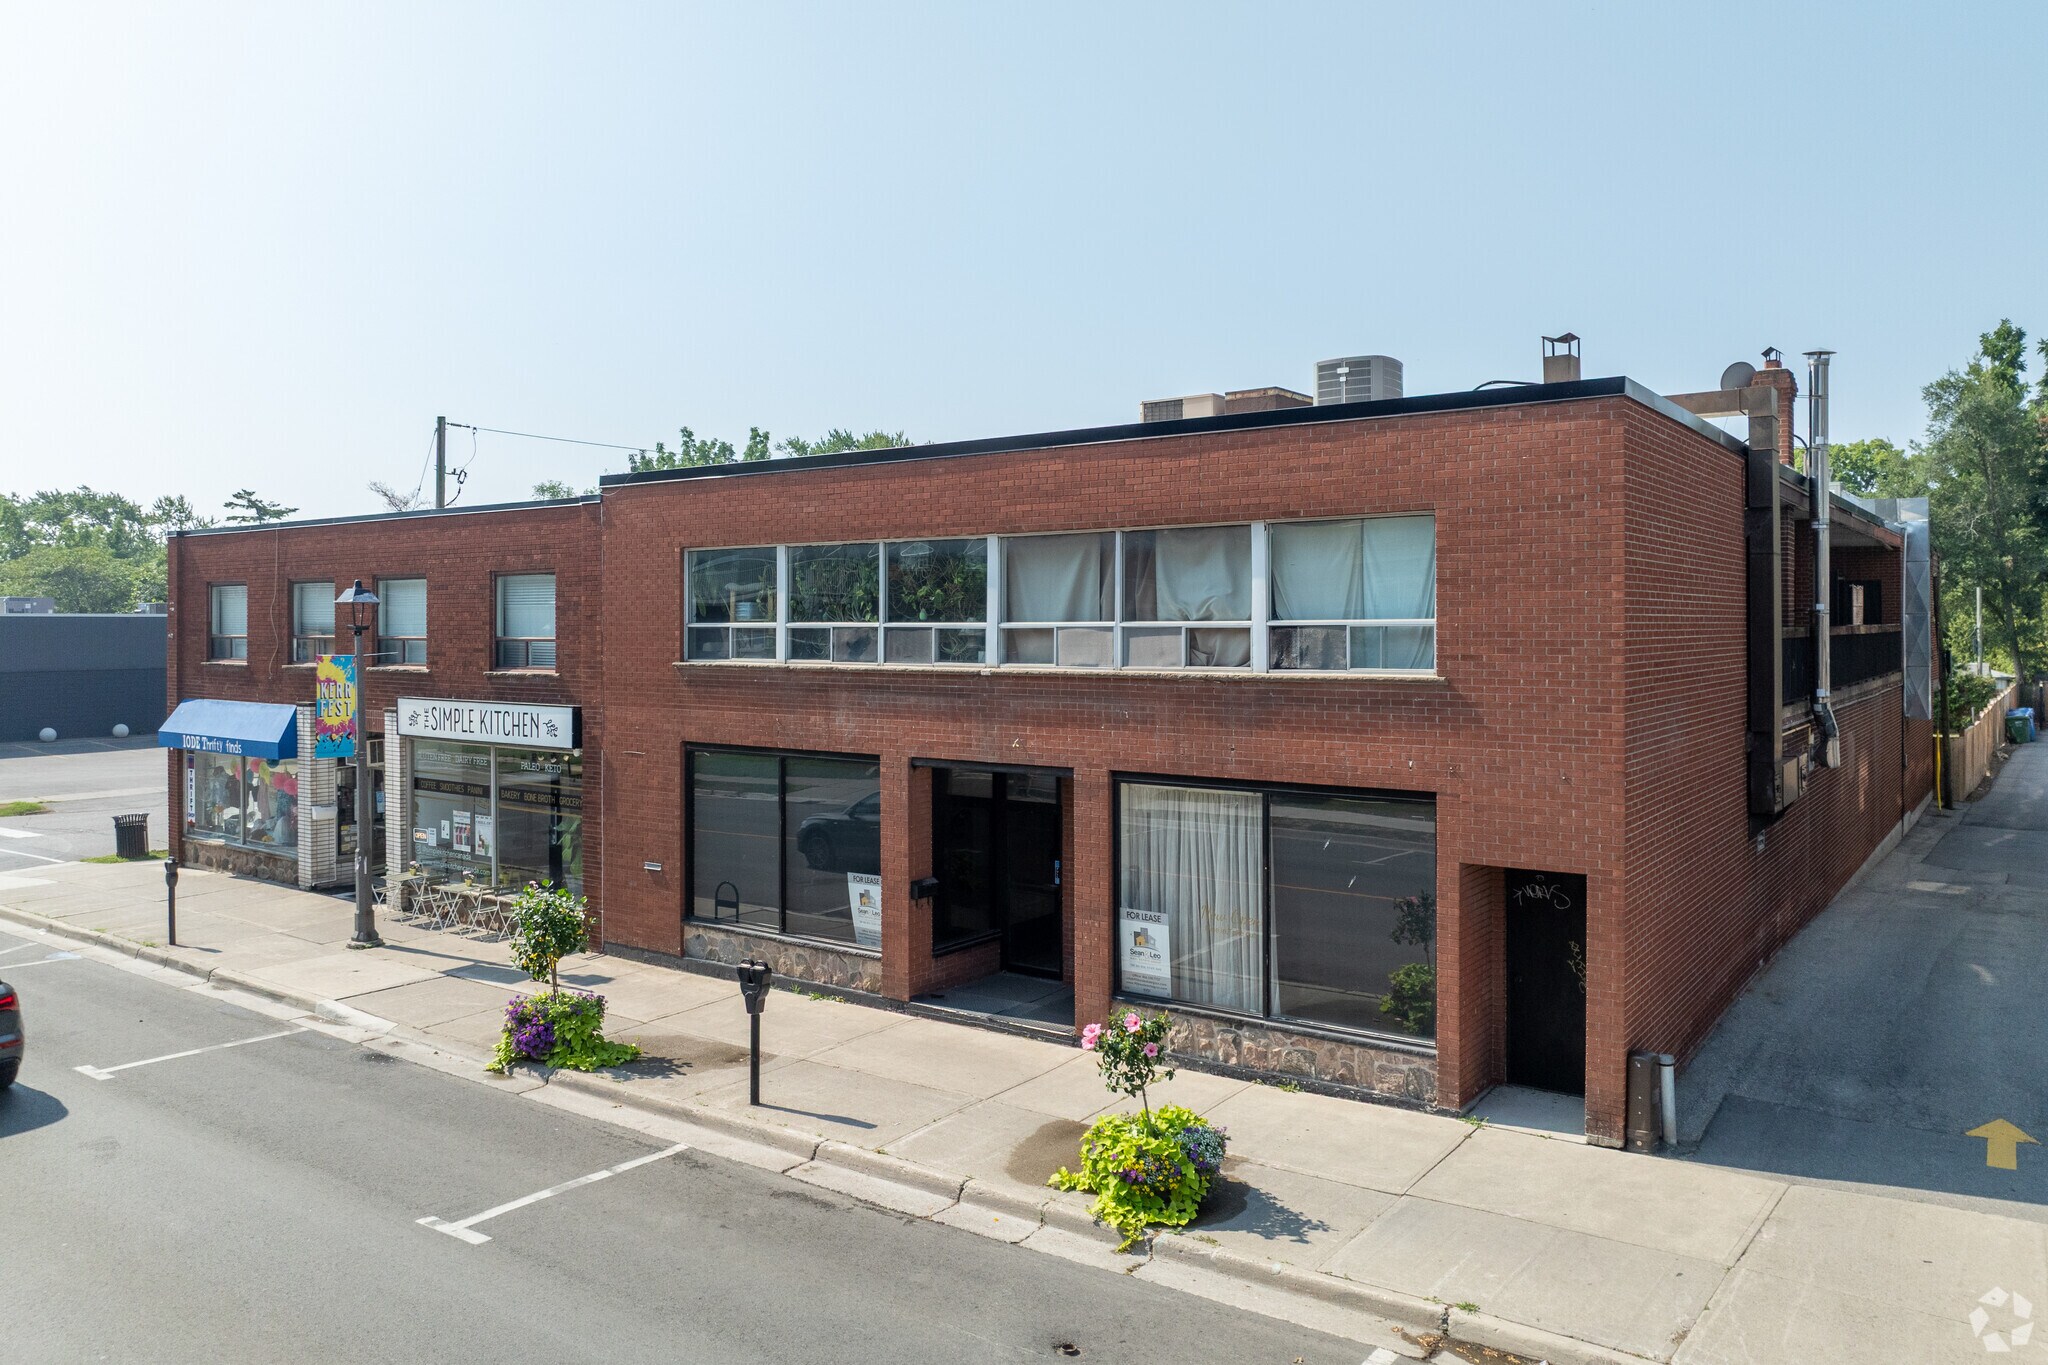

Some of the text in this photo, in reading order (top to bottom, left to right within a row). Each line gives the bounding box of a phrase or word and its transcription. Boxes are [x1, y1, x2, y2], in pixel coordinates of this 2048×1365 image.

[320, 682, 351, 699] KERR
[320, 700, 351, 717] FEST
[431, 706, 475, 734] SIMPLE
[479, 709, 540, 738] KITCHEN
[183, 735, 200, 750] IODE
[521, 762, 561, 773] PALEO KETO
[501, 790, 520, 799] BAKERY
[864, 877, 879, 885] LEASE
[1127, 911, 1161, 923] FOR LEASE
[1130, 948, 1144, 957] Sean
